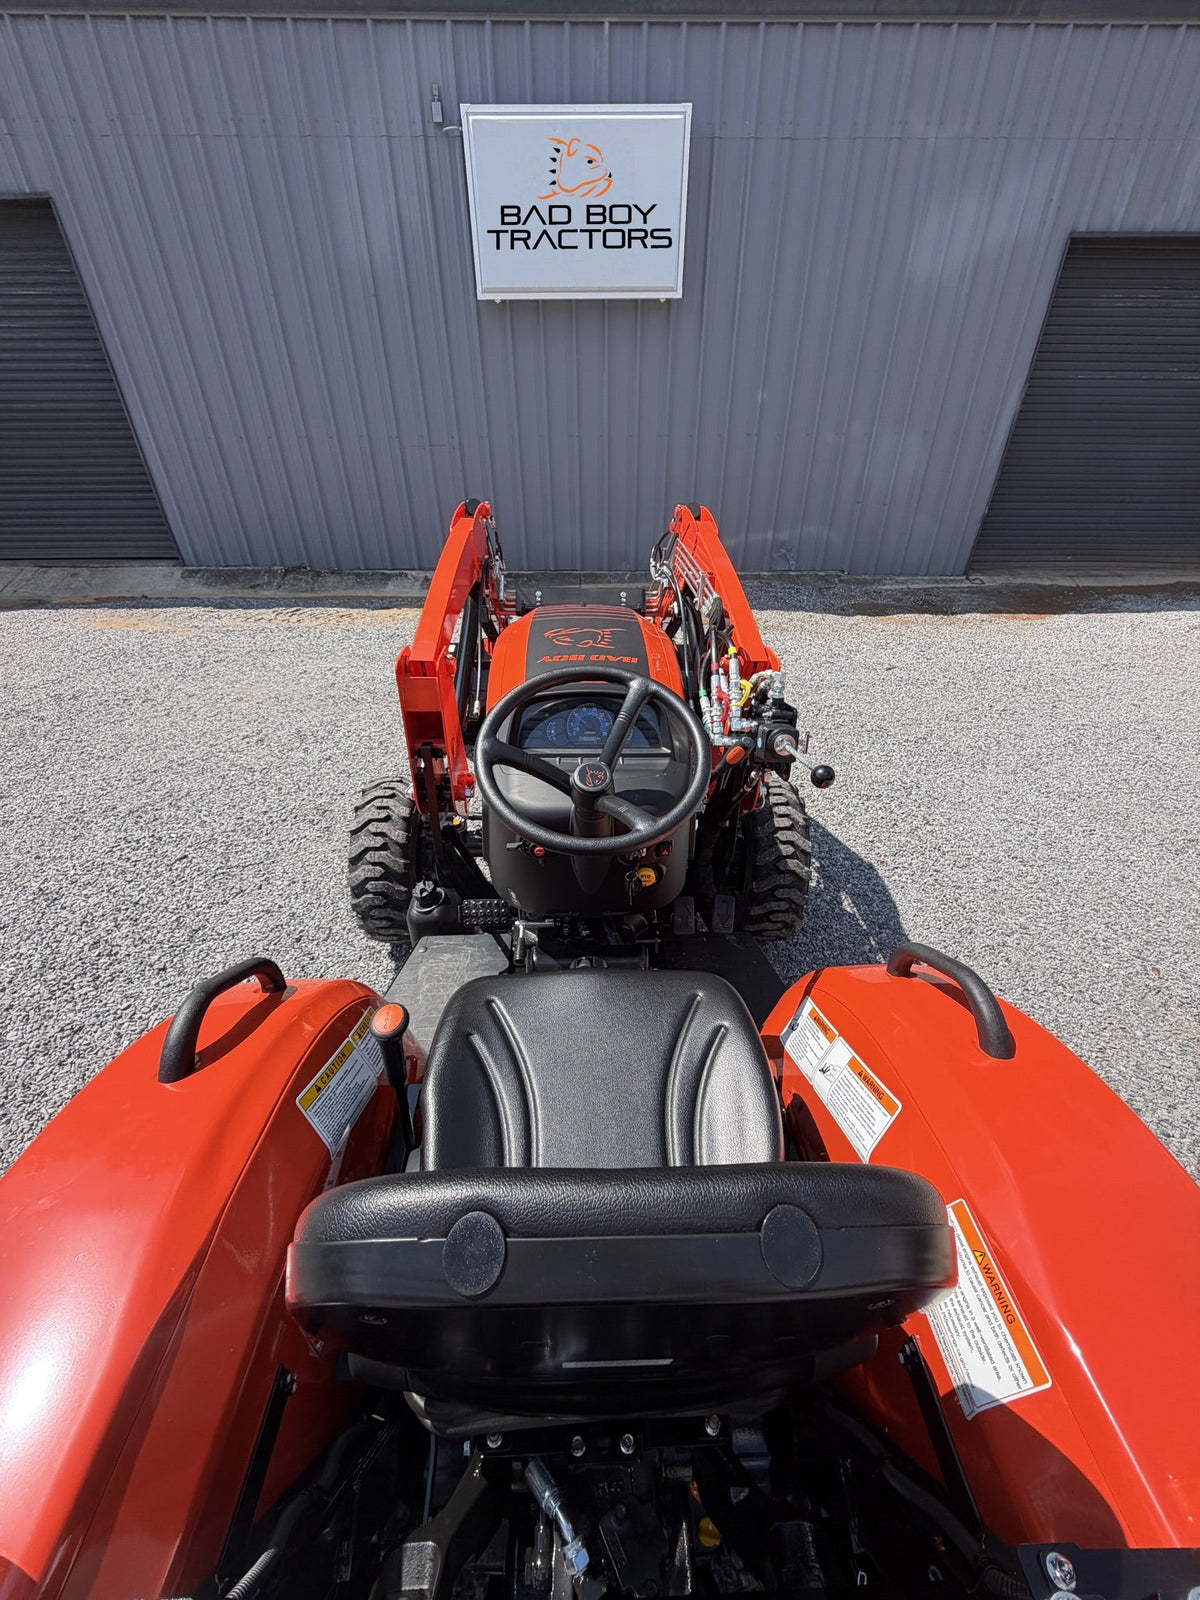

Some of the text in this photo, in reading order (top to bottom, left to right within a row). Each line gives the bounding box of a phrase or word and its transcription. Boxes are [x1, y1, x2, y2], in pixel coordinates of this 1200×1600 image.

[500, 203, 658, 226] BAD BOY
[486, 228, 673, 250] TRACTORS
[319, 1050, 347, 1085] CAUTION
[861, 1072, 884, 1101] WARNING
[980, 1263, 1016, 1324] WARNING
[990, 1311, 999, 1323] you
[1014, 1362, 1028, 1385] known
[1010, 1372, 1023, 1390] other
